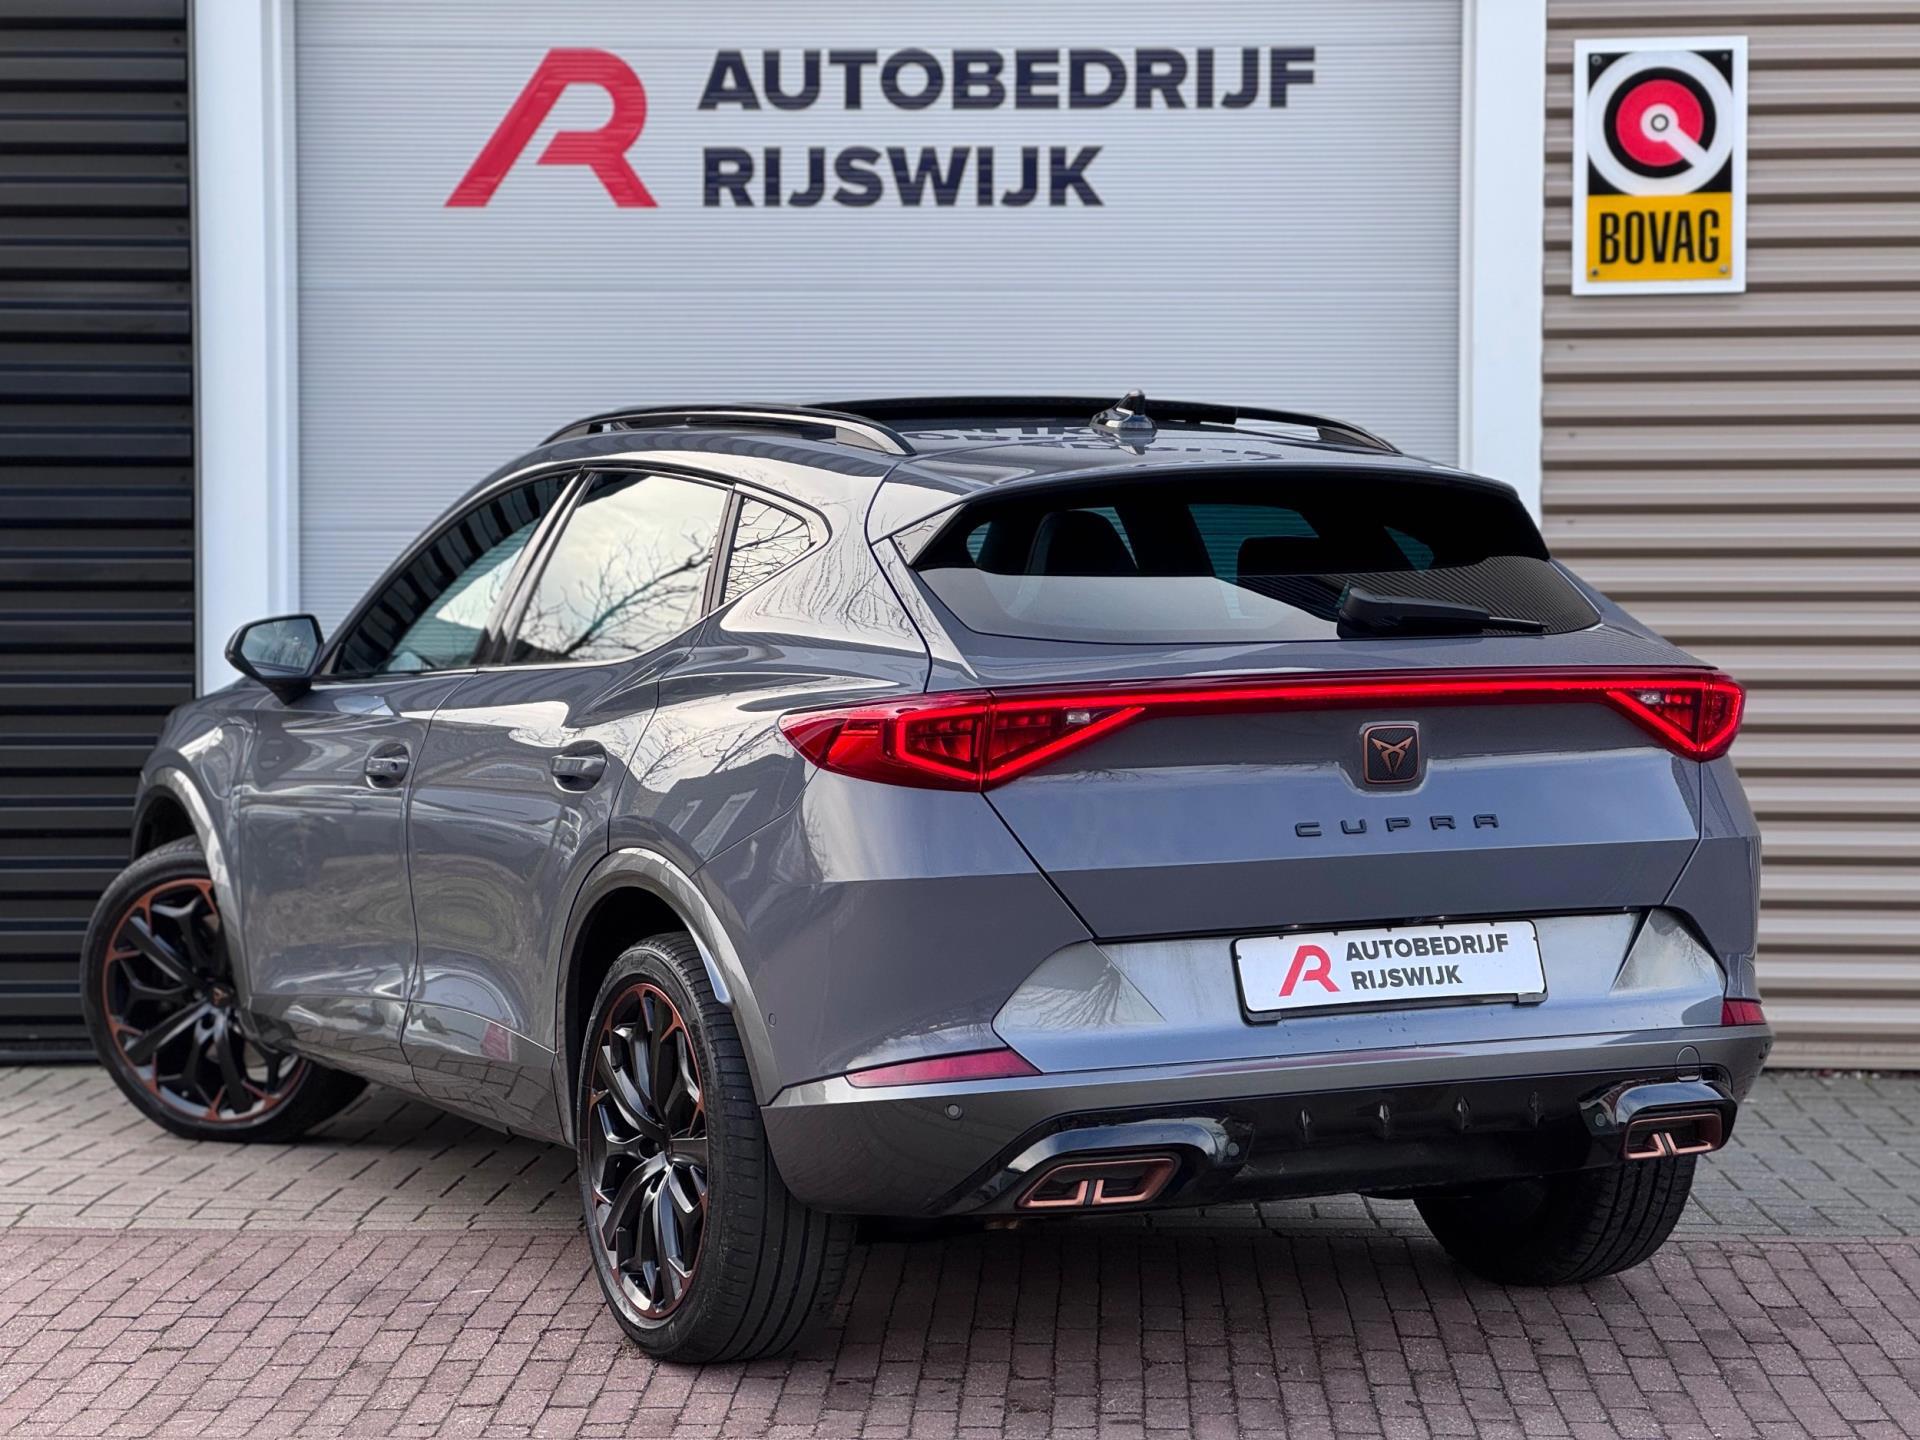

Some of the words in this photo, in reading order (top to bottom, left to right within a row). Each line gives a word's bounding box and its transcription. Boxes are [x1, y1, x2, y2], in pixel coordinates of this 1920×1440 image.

[698, 47, 1315, 110] AUTOBEDRIJF
[701, 146, 1105, 207] RIJSWIJK
[1600, 208, 1720, 265] BOVAG
[1295, 814, 1500, 838] CUPRA
[1346, 933, 1509, 961] AUTOBEDRIJF
[1351, 965, 1463, 990] RIJSWIJK
